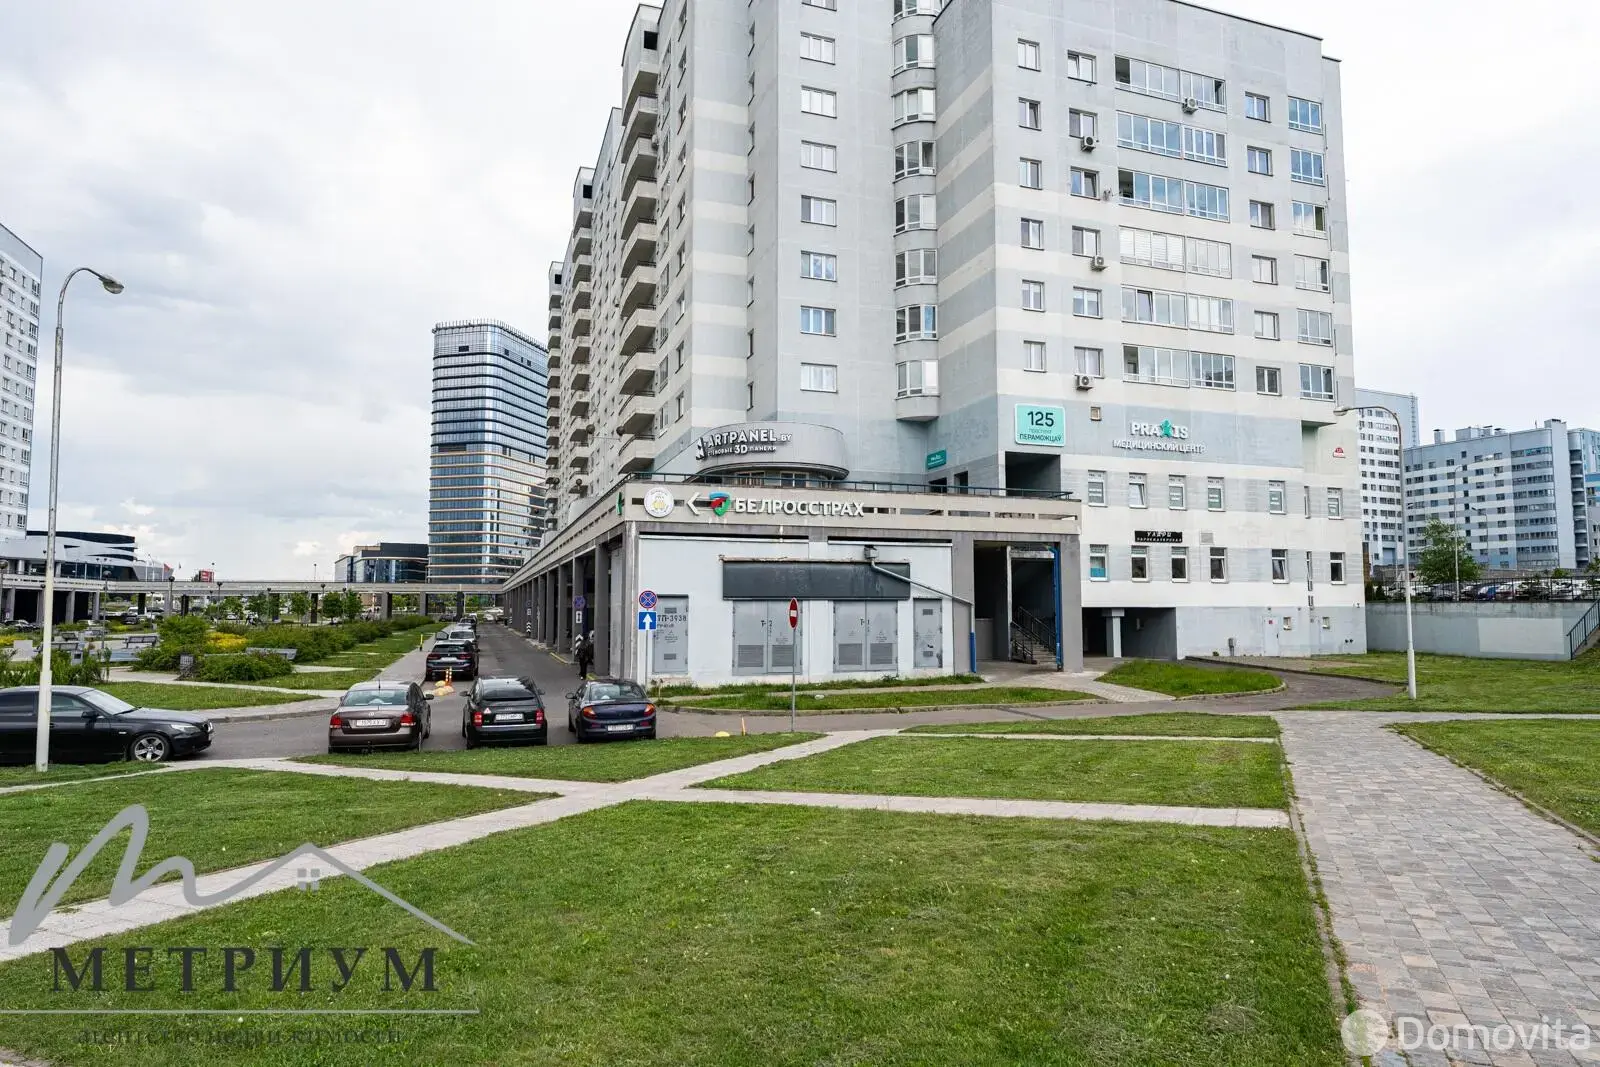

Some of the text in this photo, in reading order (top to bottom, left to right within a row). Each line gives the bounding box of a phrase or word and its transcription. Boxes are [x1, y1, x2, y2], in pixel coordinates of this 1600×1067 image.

[1027, 411, 1054, 427] 125
[734, 444, 748, 454] 3D
[749, 445, 777, 453] ПАНЕЛИ
[1112, 439, 1179, 453] МЕДИЦИНСКИЙ
[735, 498, 865, 517] БЕЛРОССТРАХ
